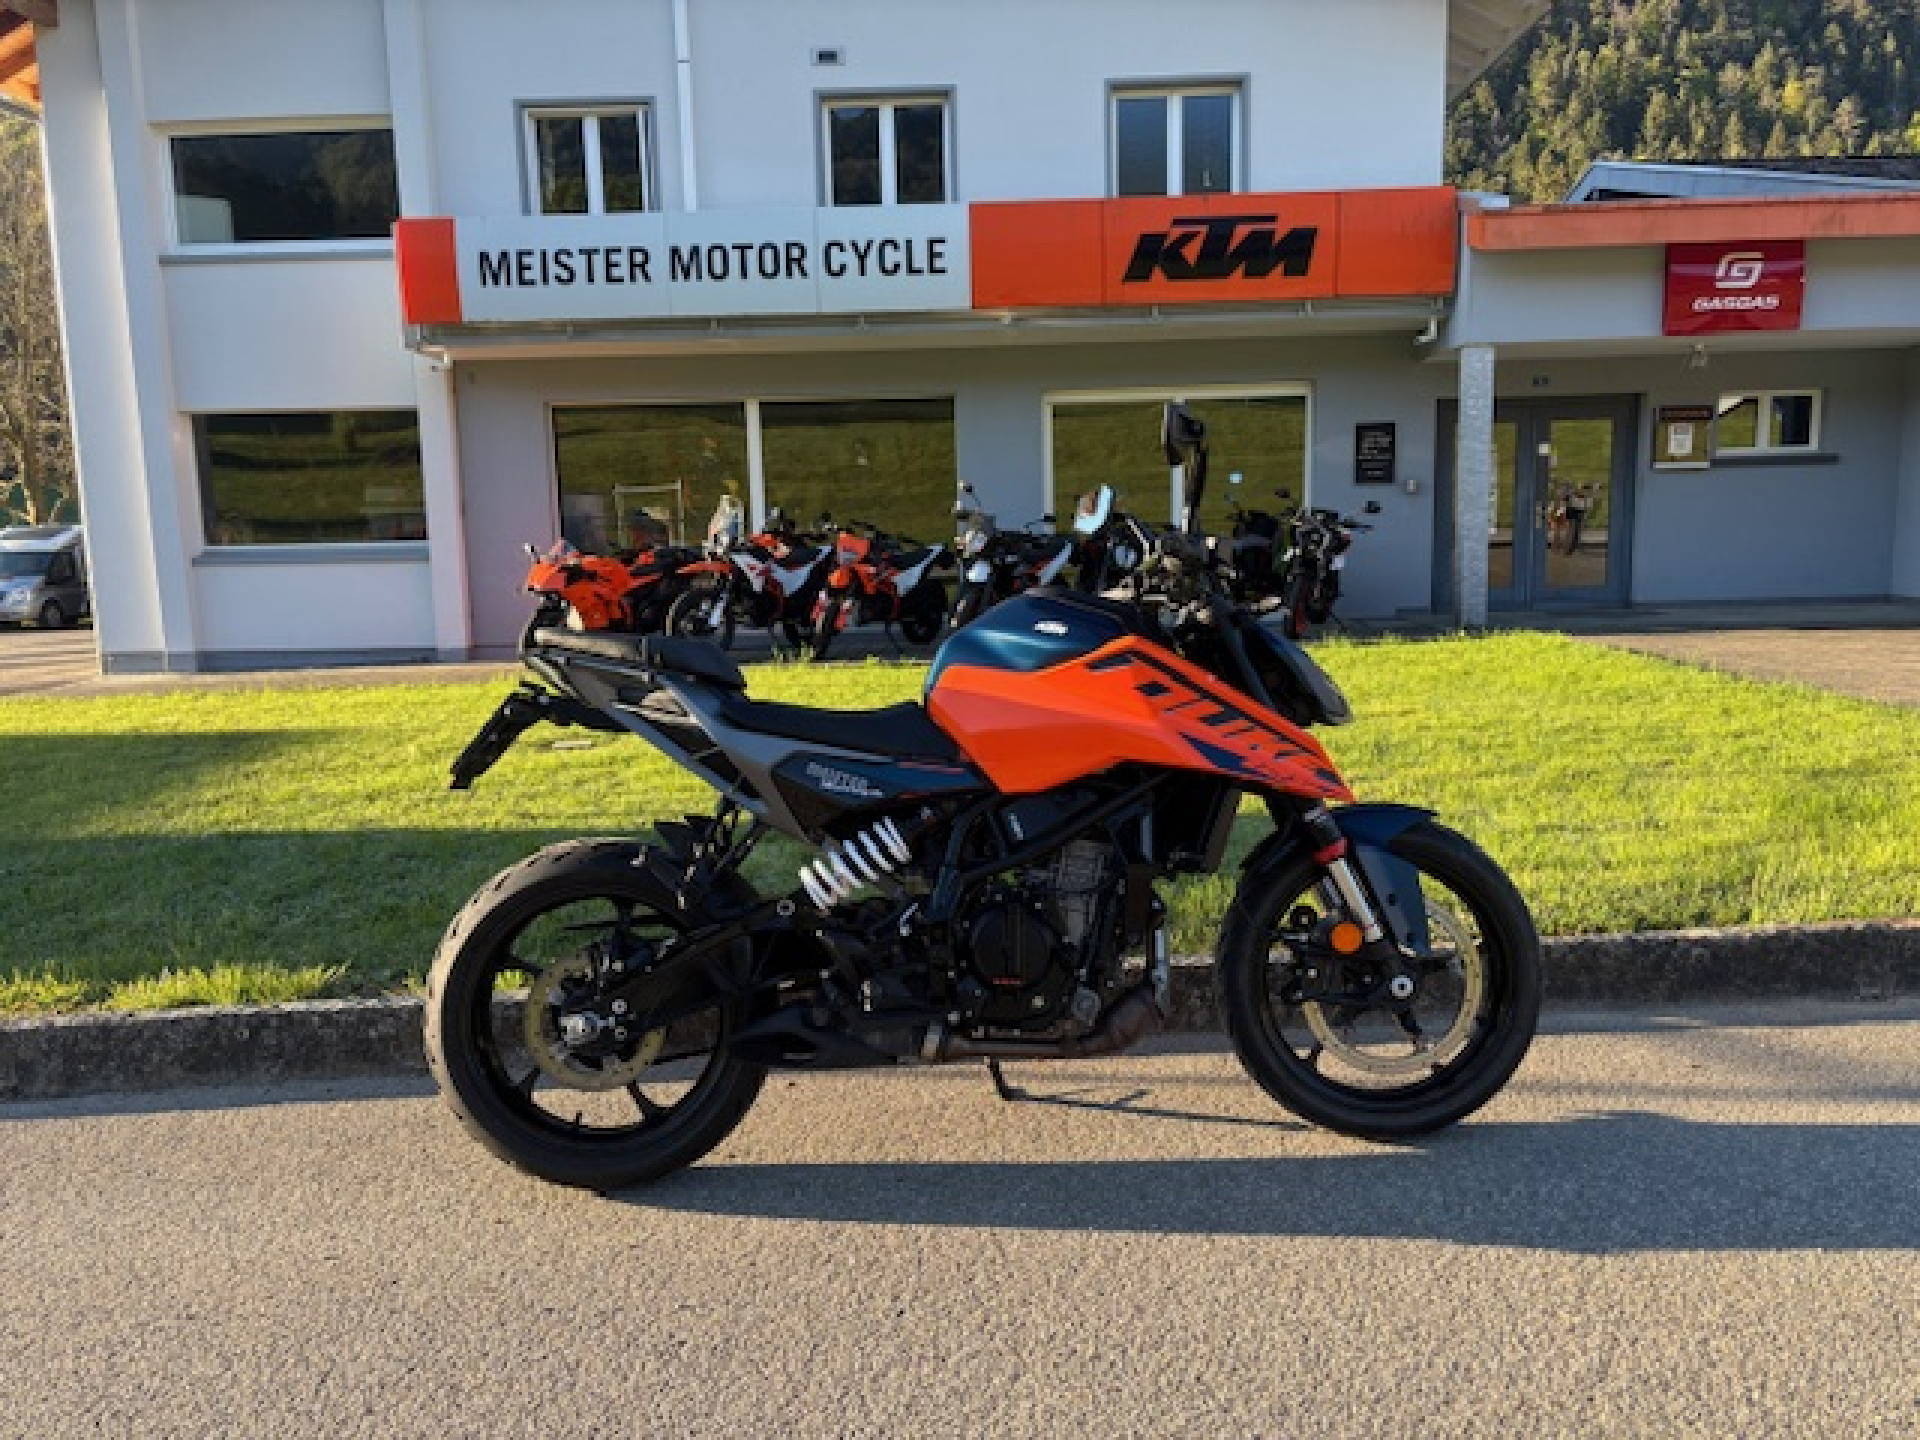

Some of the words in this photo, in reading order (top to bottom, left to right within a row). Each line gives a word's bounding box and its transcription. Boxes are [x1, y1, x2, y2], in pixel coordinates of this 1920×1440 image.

[479, 247, 652, 288] MEISTER
[670, 241, 809, 282] MOTOR
[824, 237, 949, 277] CYCLE
[1122, 214, 1318, 284] KTM
[1691, 294, 1781, 313] GASGAS
